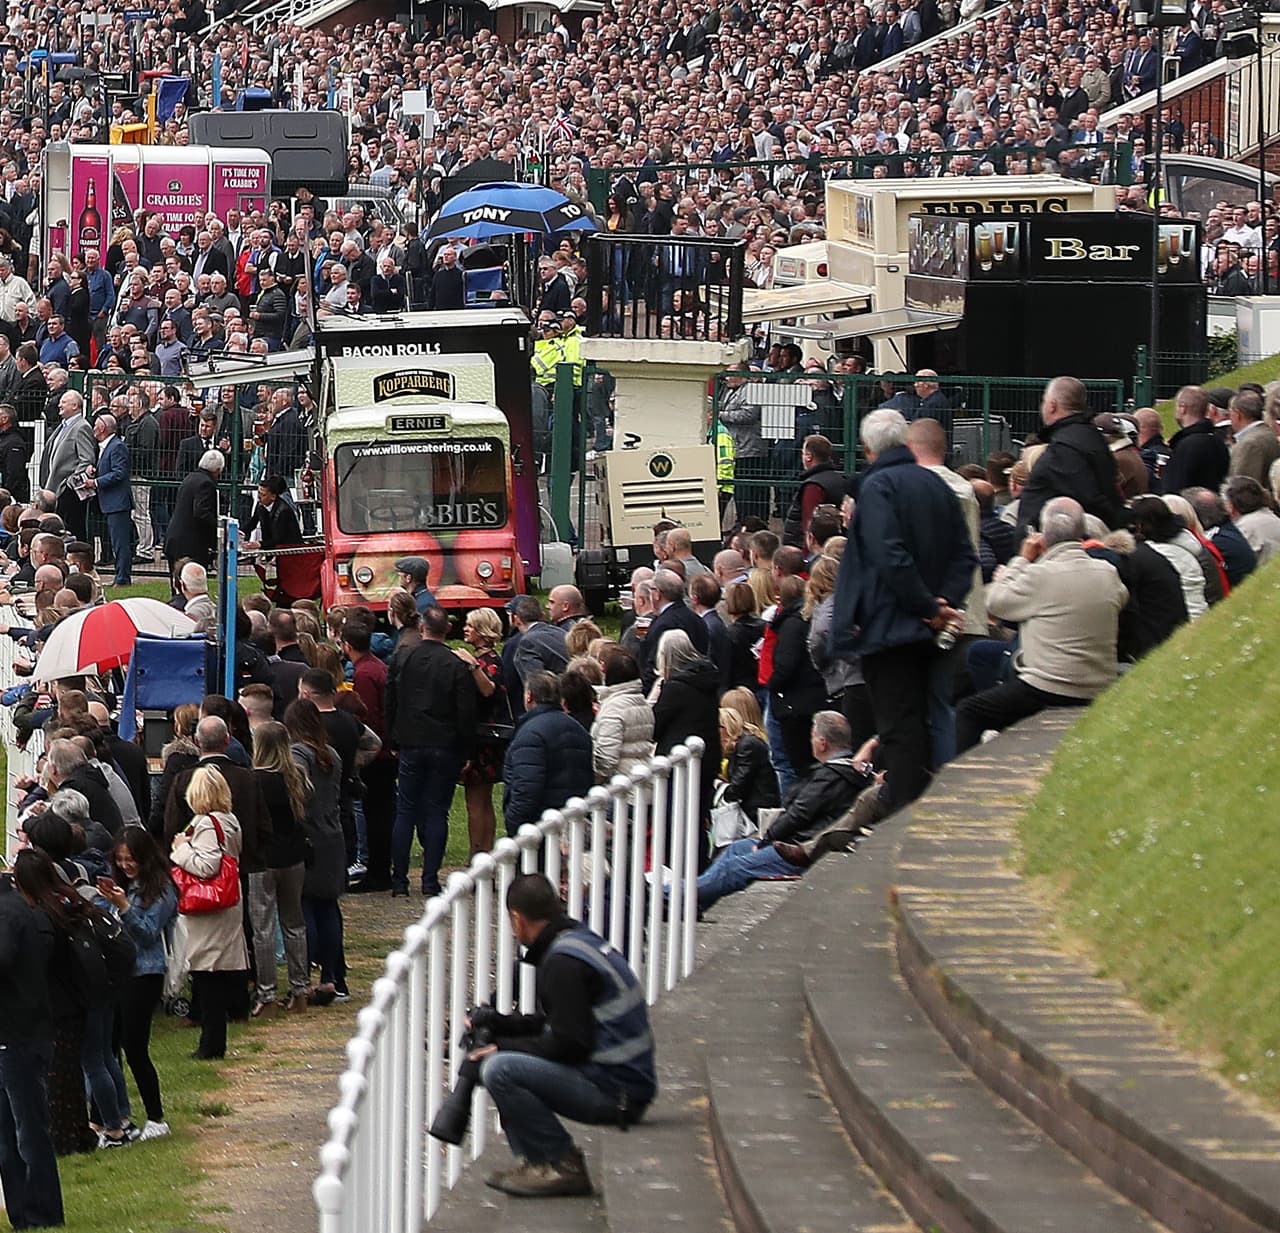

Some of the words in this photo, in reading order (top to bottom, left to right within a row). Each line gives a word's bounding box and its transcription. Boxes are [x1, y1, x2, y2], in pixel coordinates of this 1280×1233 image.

[223, 178, 229, 188] A
[146, 193, 203, 206] CRABBIE'S
[463, 207, 511, 224] TONY
[560, 204, 581, 218] TO
[1043, 238, 1140, 260] Bar
[342, 345, 391, 358] BACON
[397, 343, 441, 355] ROLLS
[378, 375, 449, 397] KOPPARBERG
[396, 418, 442, 429] ERNIE
[652, 461, 669, 472] W
